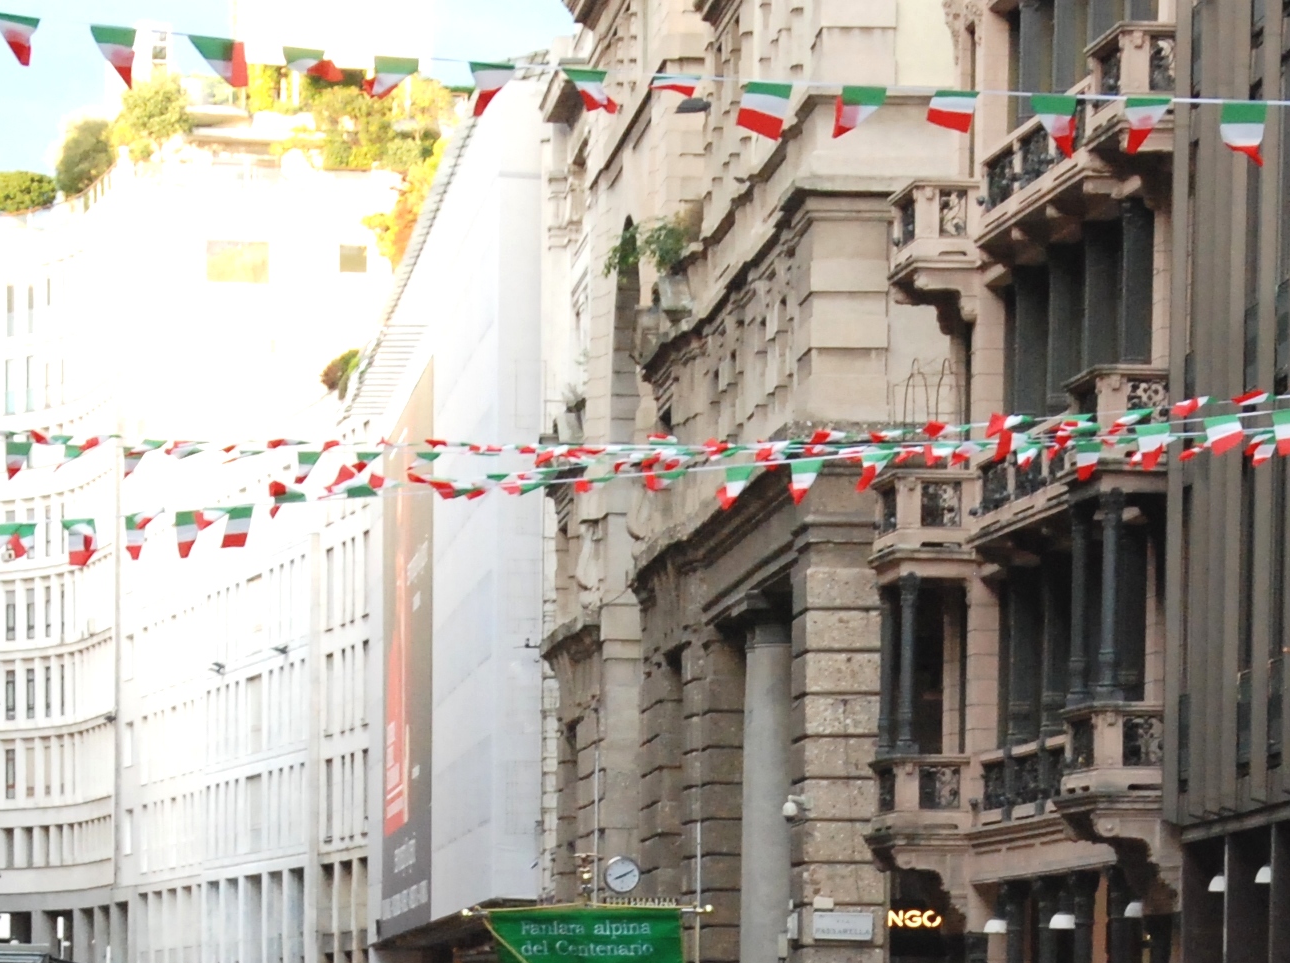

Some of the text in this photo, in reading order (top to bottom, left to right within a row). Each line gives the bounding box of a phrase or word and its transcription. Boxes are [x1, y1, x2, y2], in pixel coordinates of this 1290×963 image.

[594, 921, 652, 938] alpina
[521, 941, 653, 957] del Centenario
